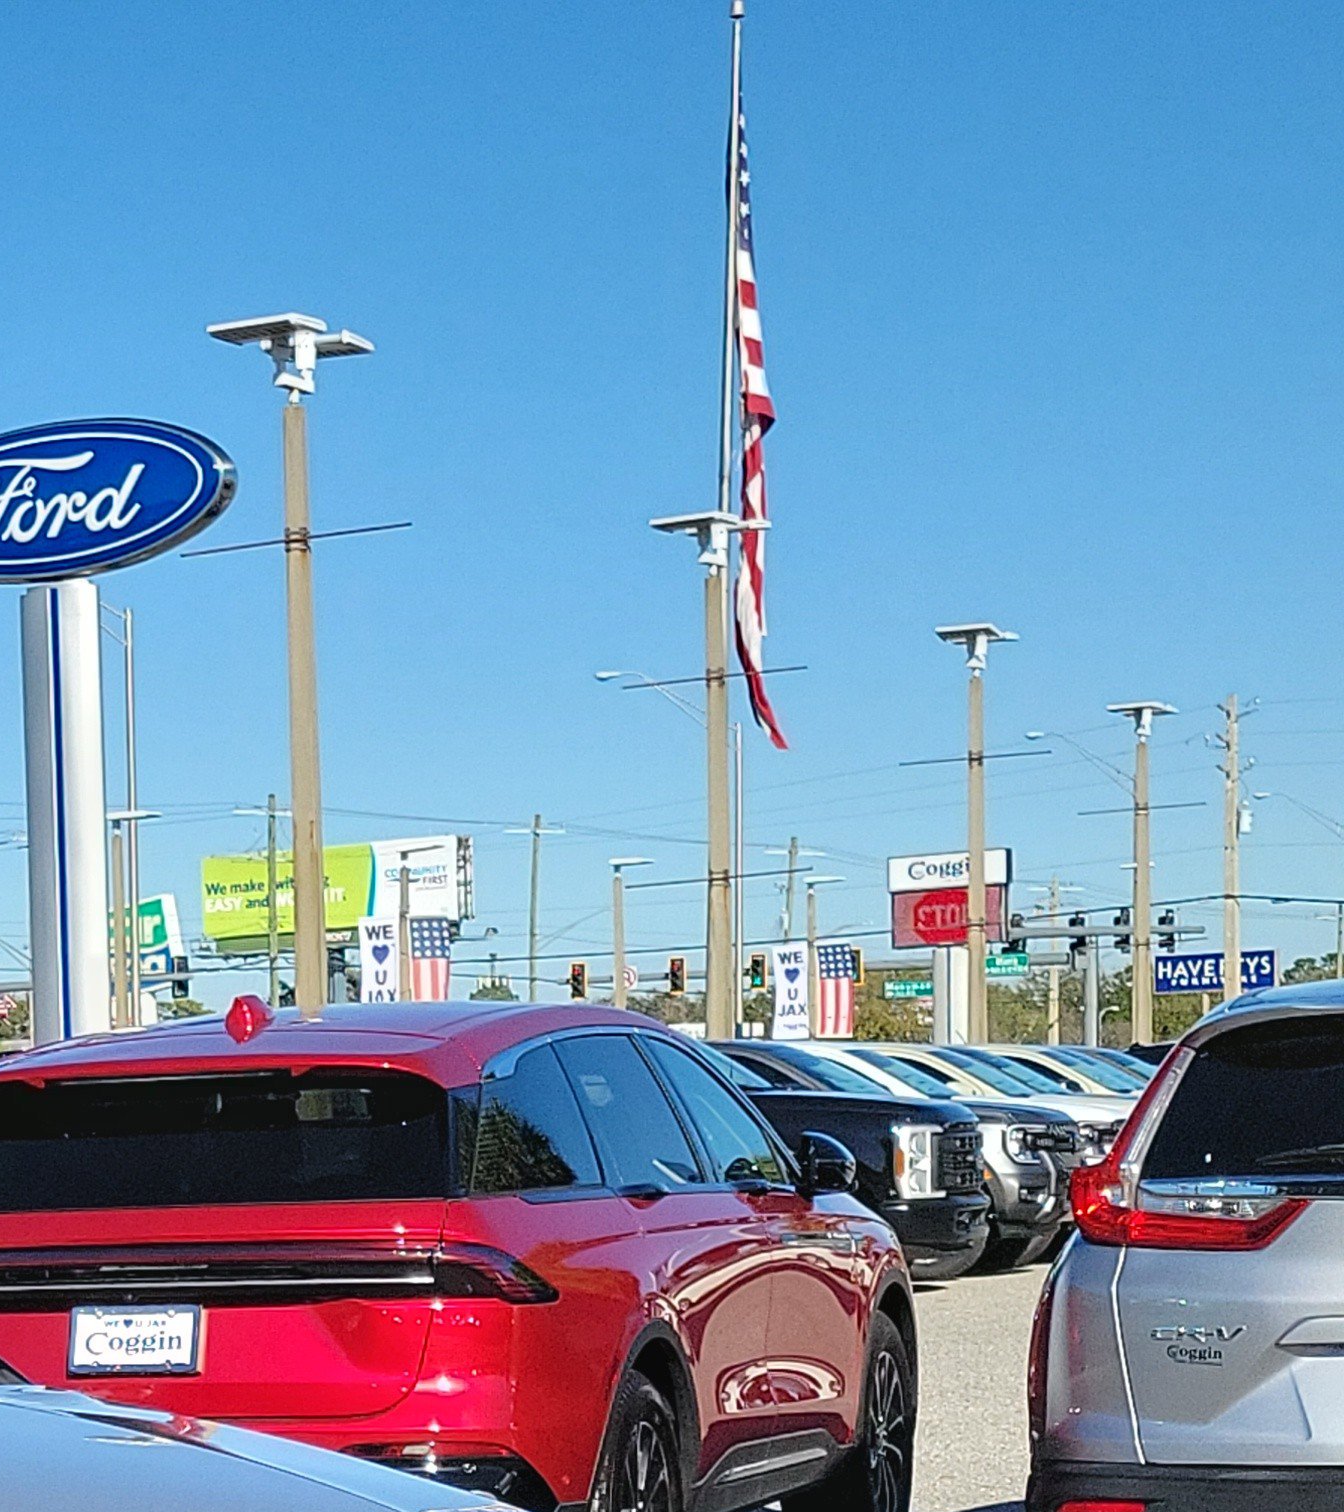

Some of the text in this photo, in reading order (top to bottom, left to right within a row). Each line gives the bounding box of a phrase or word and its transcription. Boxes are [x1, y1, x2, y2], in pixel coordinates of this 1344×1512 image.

[908, 857, 970, 880] Coggi
[205, 882, 227, 895] We
[230, 878, 265, 893] make
[205, 896, 243, 913] EASY
[245, 895, 270, 909] and
[917, 902, 968, 931] STO
[365, 924, 395, 941] WE
[777, 951, 804, 965] WE
[1157, 955, 1271, 980] HAVEYS
[375, 970, 387, 986] U
[787, 987, 798, 1001] U
[777, 1003, 808, 1018] JAX
[1151, 1325, 1248, 1342] CR-V
[85, 1331, 182, 1355] Coggin
[1167, 1344, 1223, 1360] Coggin
